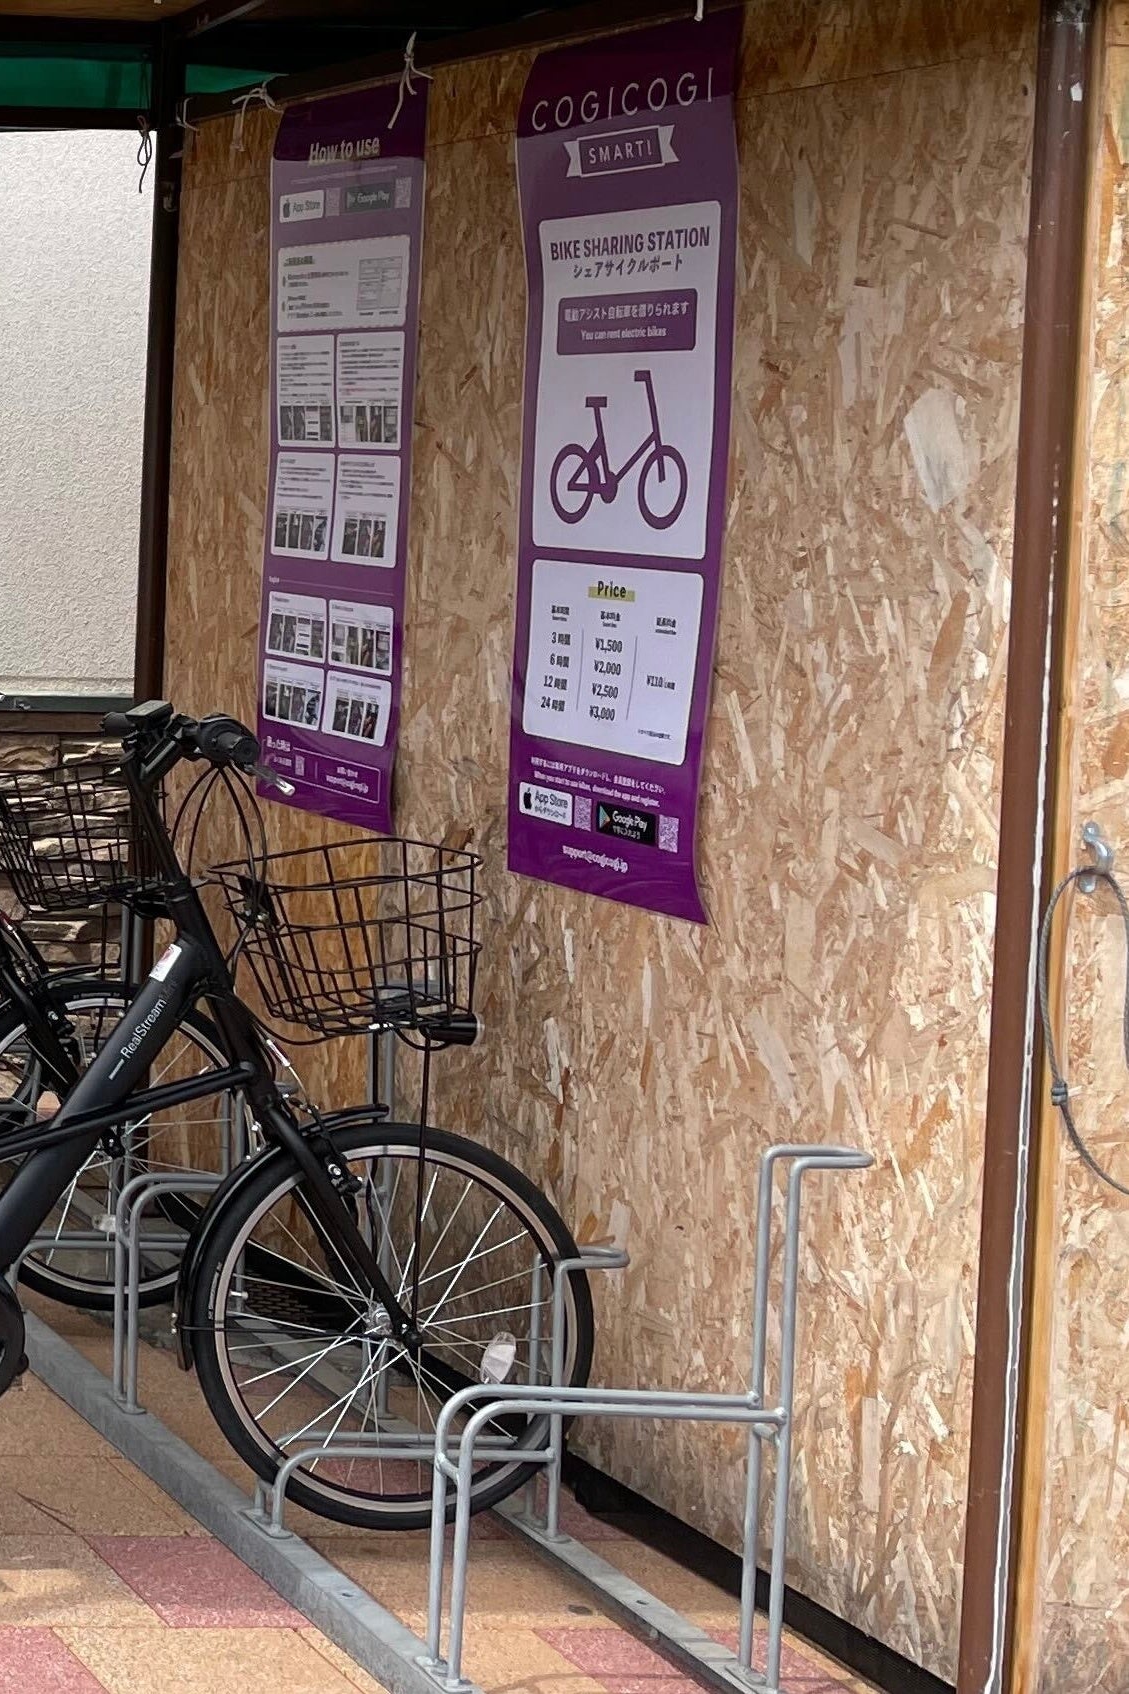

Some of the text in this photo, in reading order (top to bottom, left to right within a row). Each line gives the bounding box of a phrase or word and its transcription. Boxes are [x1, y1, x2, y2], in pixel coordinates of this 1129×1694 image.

[532, 67, 713, 131] COGICOGI
[309, 137, 380, 164] How to use
[550, 226, 711, 261] BIKE SHARING STATION
[581, 325, 667, 341] You can rent electric bikes
[597, 581, 627, 598] Price
[595, 637, 623, 654] ¥1,500
[594, 660, 621, 677] ¥2,000
[592, 683, 619, 699] ¥2,500
[589, 705, 616, 721] ¥3,000
[535, 790, 568, 809] App Store
[612, 810, 648, 832] Google Play
[120, 998, 168, 1060] RealStream
